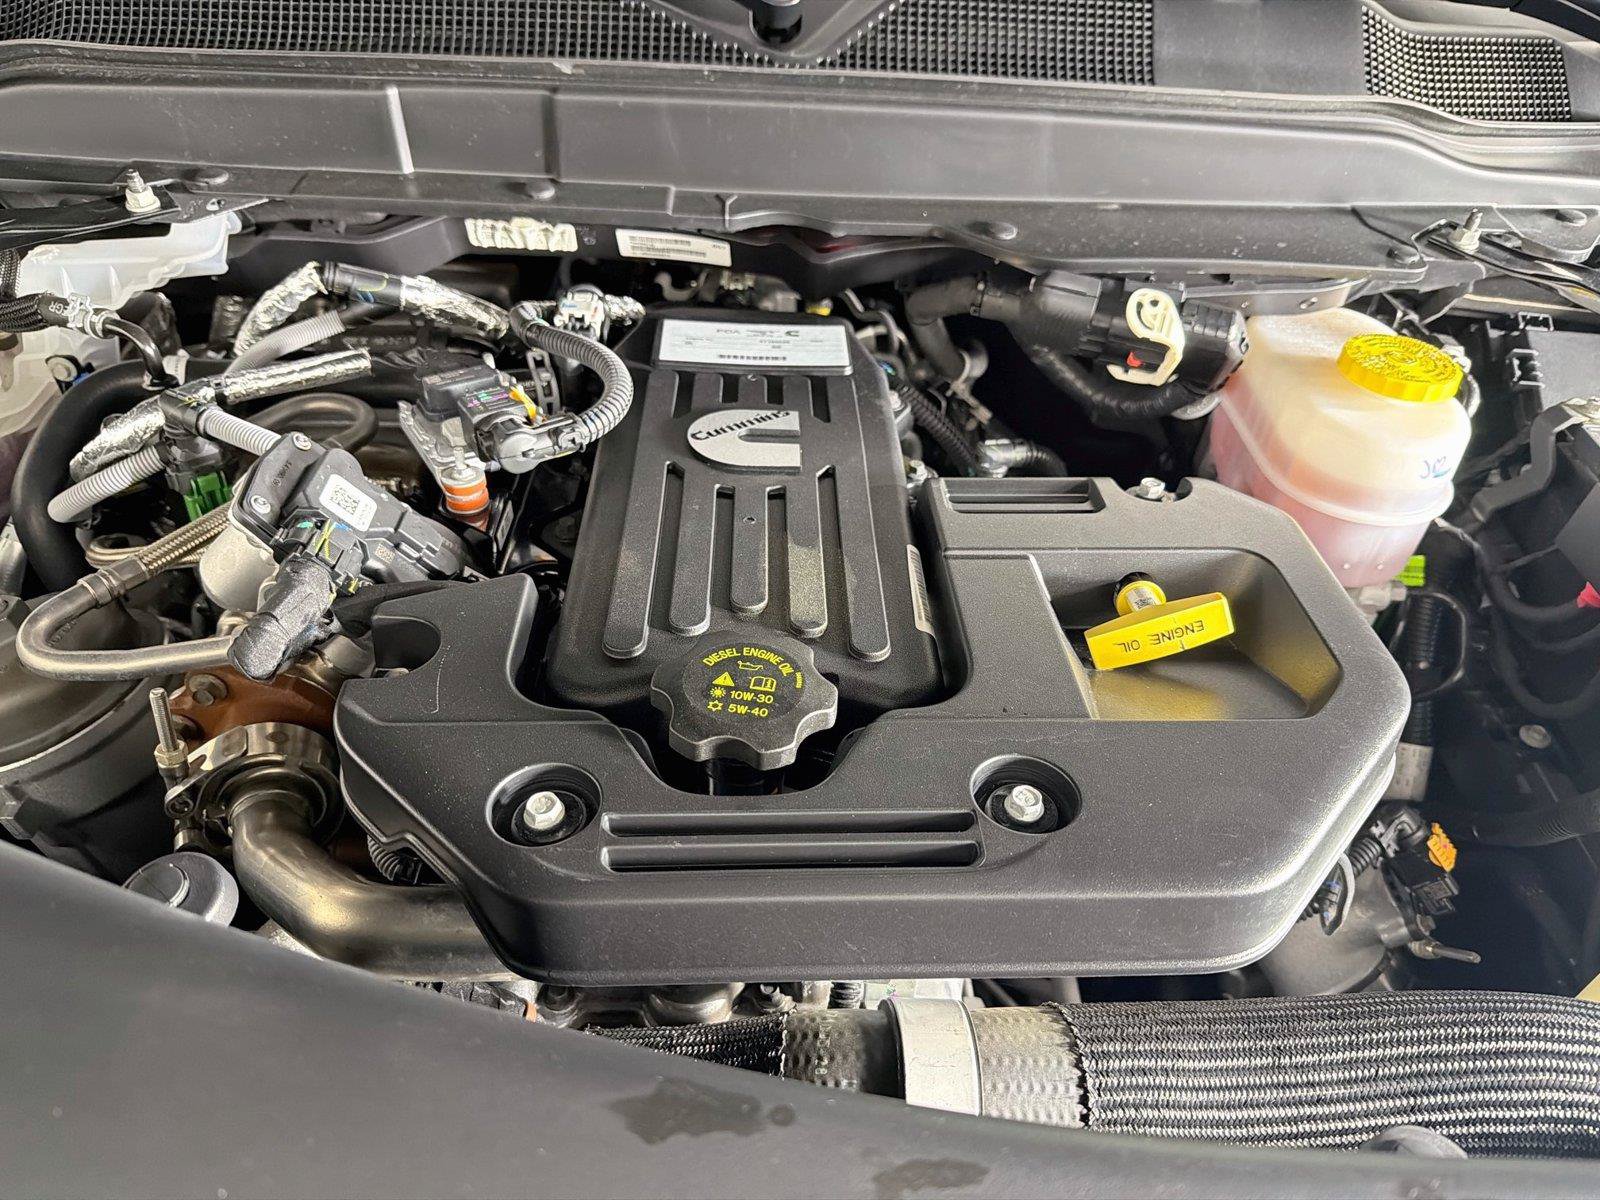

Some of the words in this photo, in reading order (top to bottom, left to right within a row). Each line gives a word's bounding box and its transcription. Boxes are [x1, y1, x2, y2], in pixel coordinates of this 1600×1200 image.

[690, 410, 791, 442] Cummins
[1148, 620, 1204, 646] ENGINE
[1113, 639, 1141, 653] OIL
[702, 647, 741, 667] DIESEL
[742, 647, 784, 665] ENGINE
[778, 662, 795, 677] OIL
[730, 690, 774, 704] 10W-30
[727, 705, 769, 718] 5W-40
